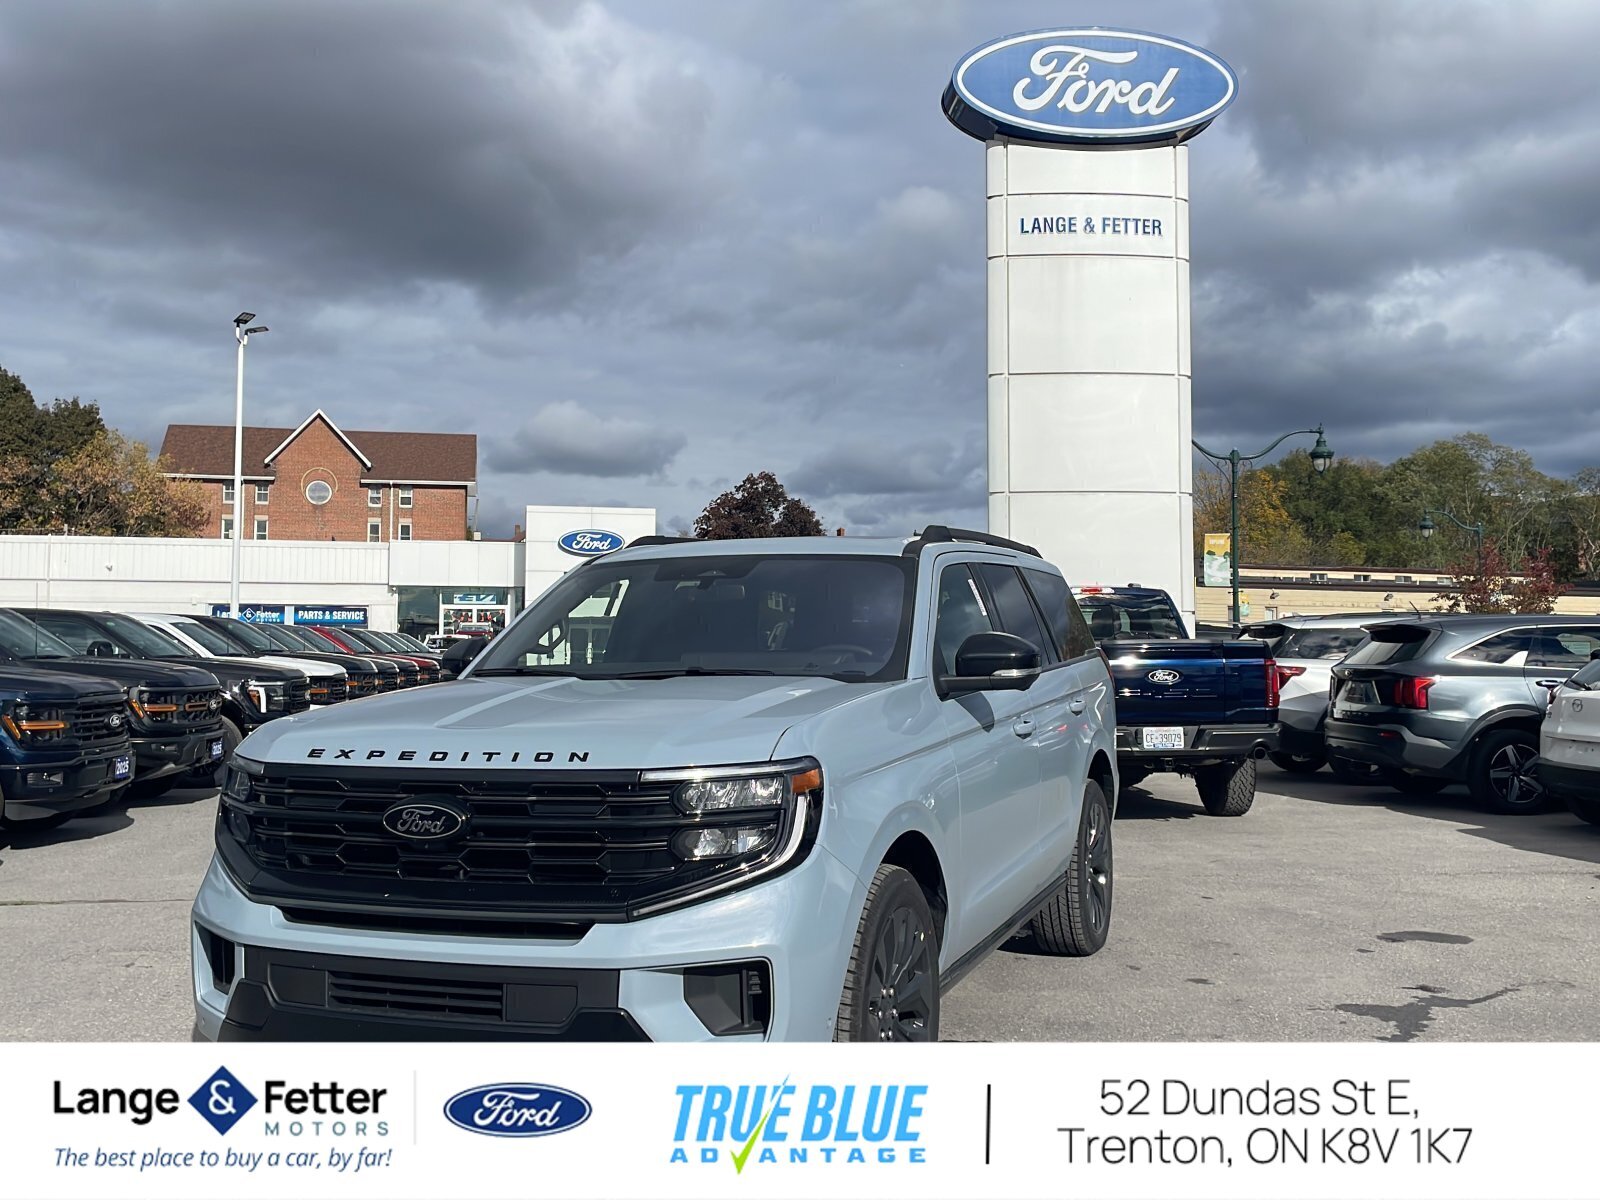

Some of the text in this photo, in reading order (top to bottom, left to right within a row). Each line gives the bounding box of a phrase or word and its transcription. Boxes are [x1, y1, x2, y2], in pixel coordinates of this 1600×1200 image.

[1012, 45, 1180, 116] Ford
[1020, 216, 1163, 236] LANGE & FETTER
[571, 533, 611, 551] Ford
[298, 610, 364, 620] PARTS & SERVICE
[1153, 670, 1174, 681] Ford
[307, 748, 590, 763] EXPEDITION
[396, 807, 446, 833] Ford
